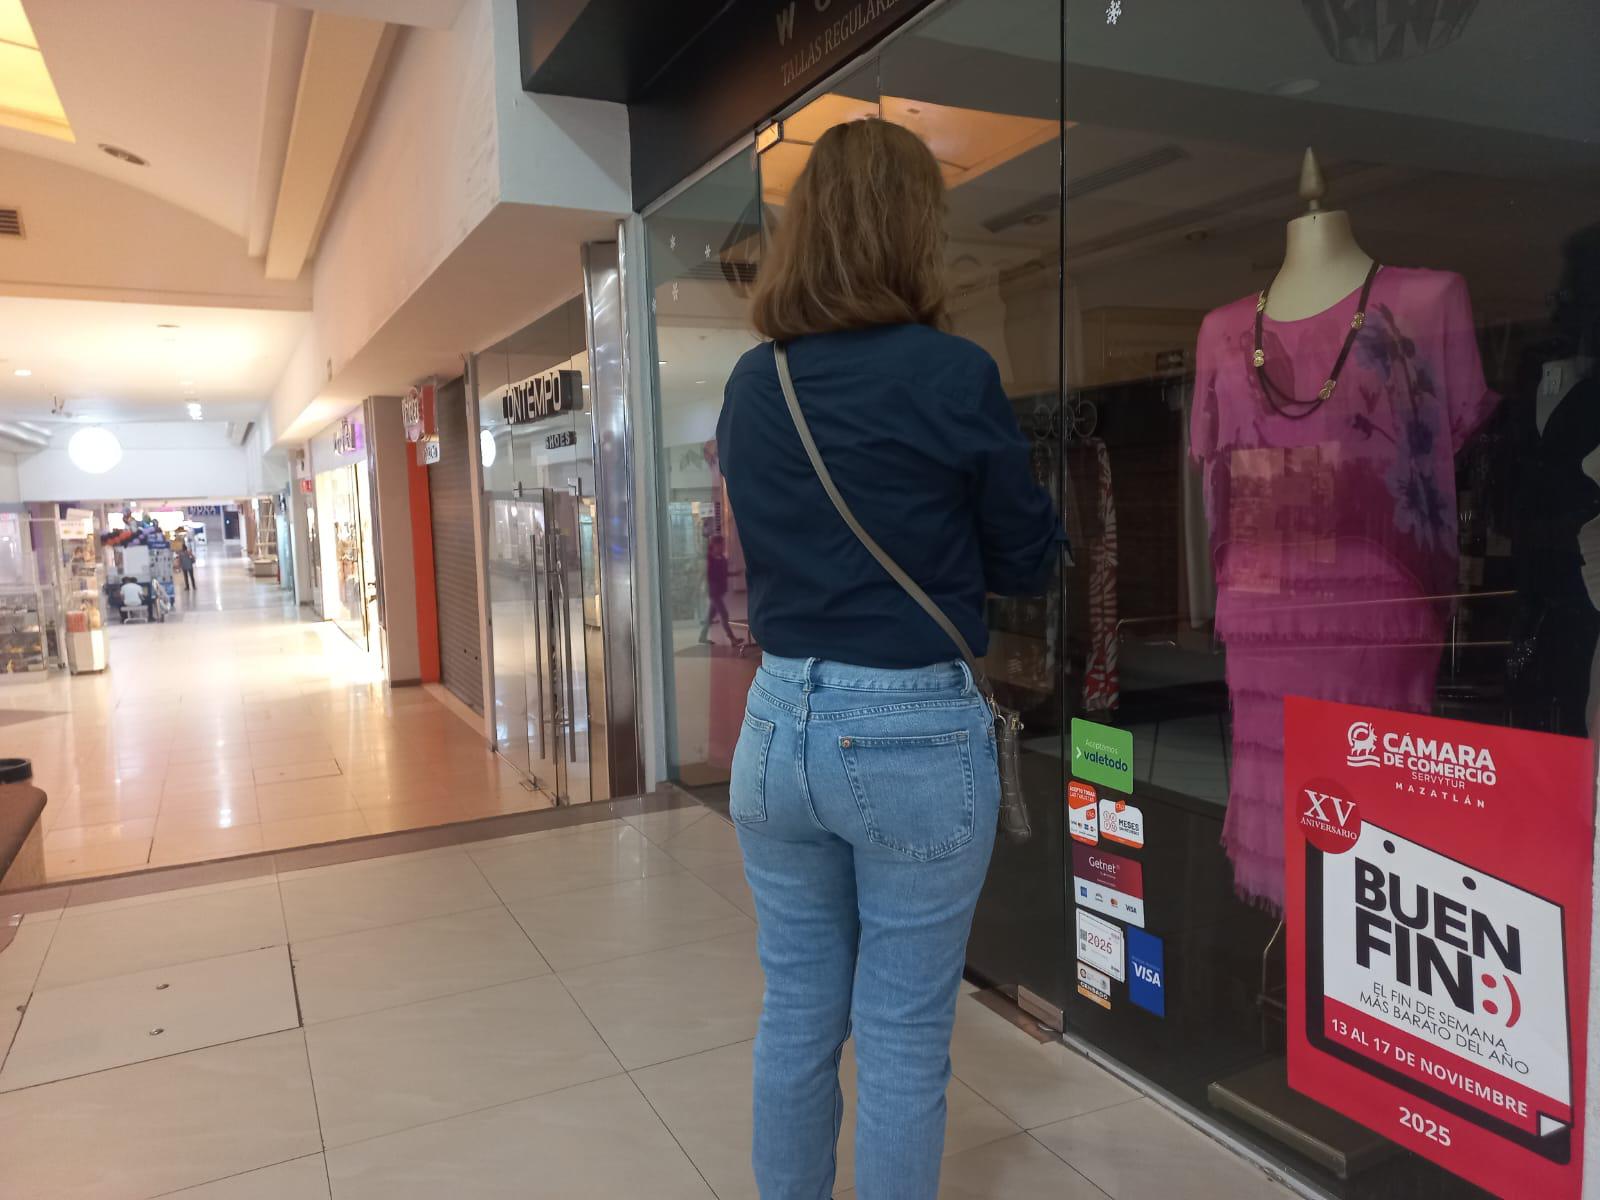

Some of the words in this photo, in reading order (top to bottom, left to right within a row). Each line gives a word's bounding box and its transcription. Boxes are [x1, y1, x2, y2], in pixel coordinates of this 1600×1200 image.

[781, 36, 822, 87] TALLAS
[825, 0, 898, 54] REGULAR
[545, 432, 571, 448] SHOES
[1383, 732, 1496, 771] CÁMARA
[1383, 752, 1405, 768] DE
[1407, 757, 1497, 786] COMERCIO
[1411, 772, 1465, 789] SERVYTUR
[1119, 819, 1139, 831] MESES
[1304, 789, 1356, 827] XV
[1300, 818, 1357, 840] ANIVERSARIO
[1088, 856, 1116, 874] Getnet
[1355, 856, 1521, 974] BUEN
[1087, 932, 1113, 955] 2025
[1132, 961, 1161, 987] VISA
[1360, 991, 1389, 1014] MÁS
[1393, 1006, 1451, 1041] BARATO
[1456, 1034, 1484, 1056] DEL
[1488, 1050, 1529, 1075] AÑO
[1373, 982, 1387, 998] EL
[1391, 989, 1411, 1008] FIN
[1416, 1001, 1435, 1019] DE
[1439, 1011, 1509, 1051] SEMANA
[1332, 1018, 1347, 1035] 13
[1350, 1027, 1369, 1046] AL
[1374, 1038, 1391, 1054] 17
[1395, 1047, 1416, 1067] DE
[1420, 1057, 1528, 1118] NOVIEMBRE
[1399, 1106, 1451, 1147] 2025
